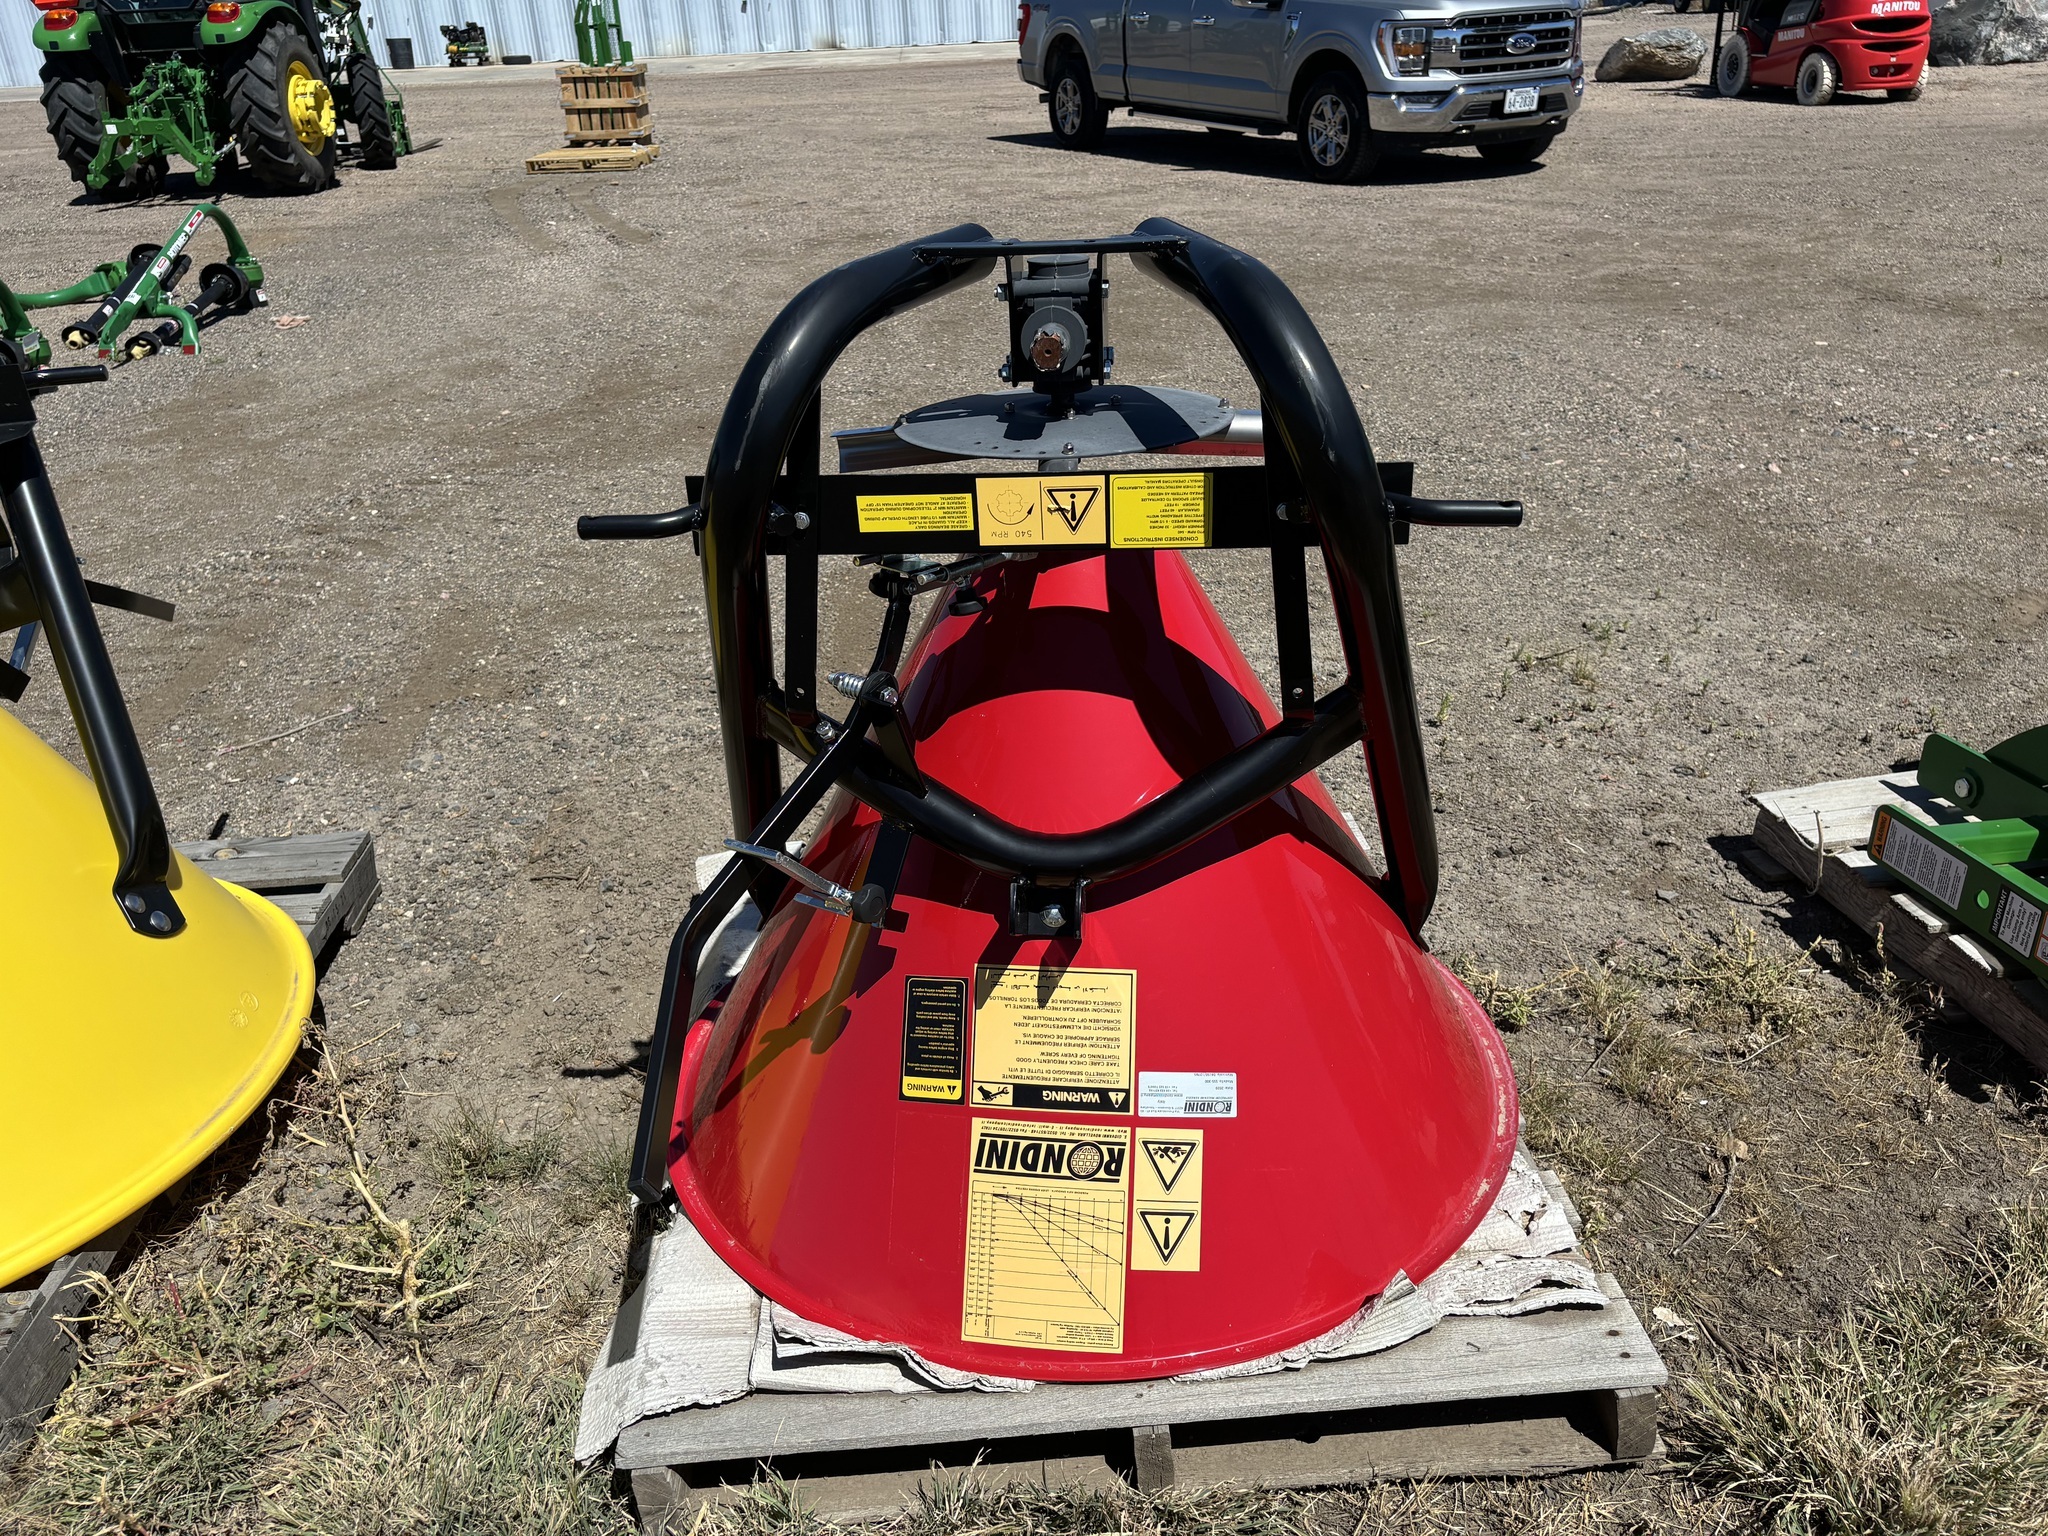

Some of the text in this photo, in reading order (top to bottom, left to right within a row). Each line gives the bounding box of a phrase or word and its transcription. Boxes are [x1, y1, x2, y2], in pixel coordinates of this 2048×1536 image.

[1871, 2, 1920, 15] MANITOU
[1778, 28, 1805, 42] MANITOU
[1876, 816, 1887, 843] WARNING
[1992, 889, 2007, 932] IMPORTANT
[907, 1083, 944, 1092] WARNING
[1043, 1090, 1100, 1103] WARNING
[1184, 1101, 1232, 1113] RONDINI
[974, 1139, 1125, 1180] RONDINI
